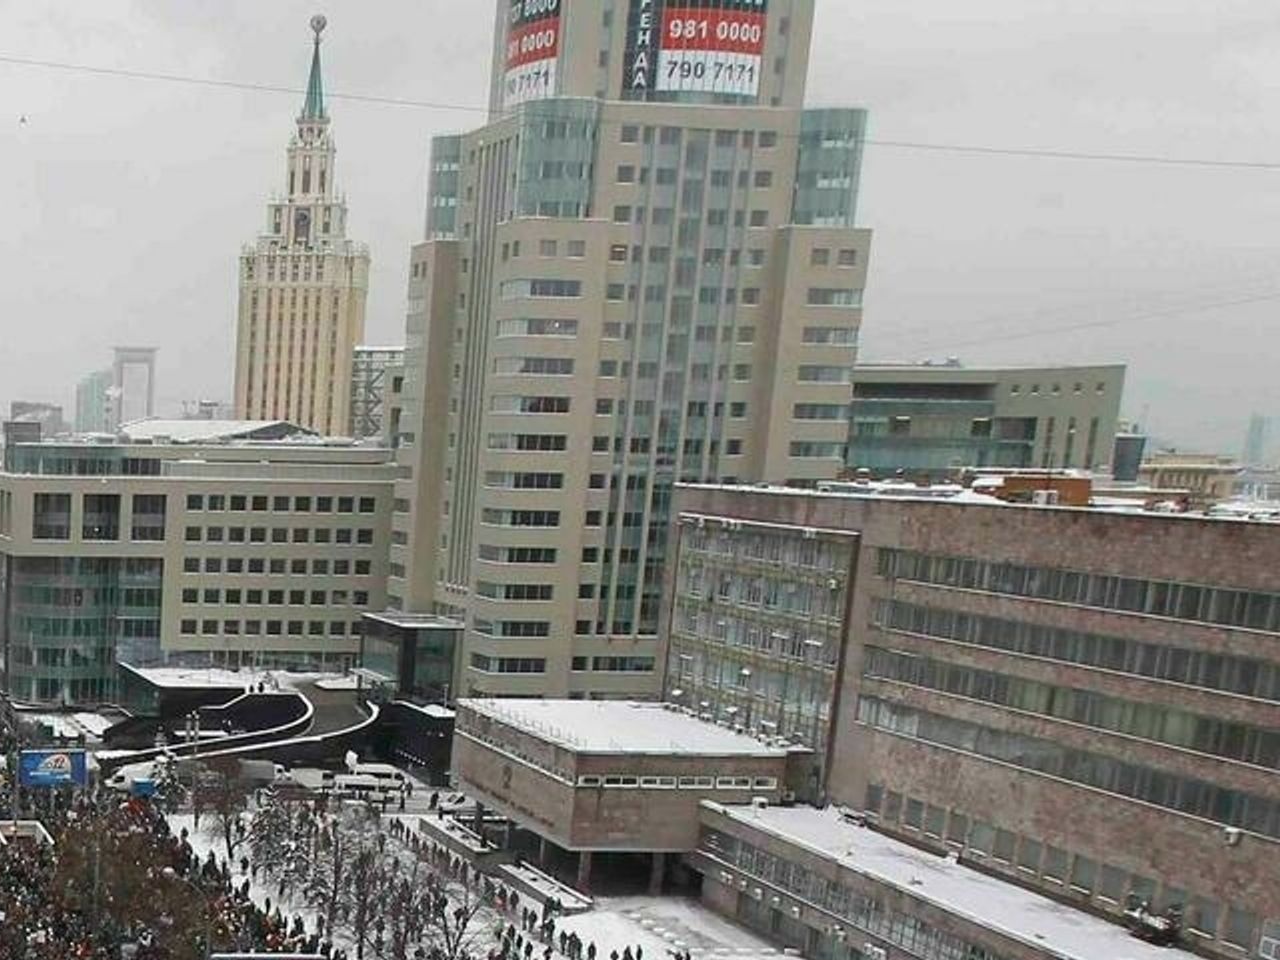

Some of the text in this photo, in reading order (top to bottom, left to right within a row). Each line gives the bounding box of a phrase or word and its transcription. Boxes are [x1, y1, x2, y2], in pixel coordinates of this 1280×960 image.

[670, 20, 761, 43] 981 0000
[667, 60, 754, 83] 790 7171
